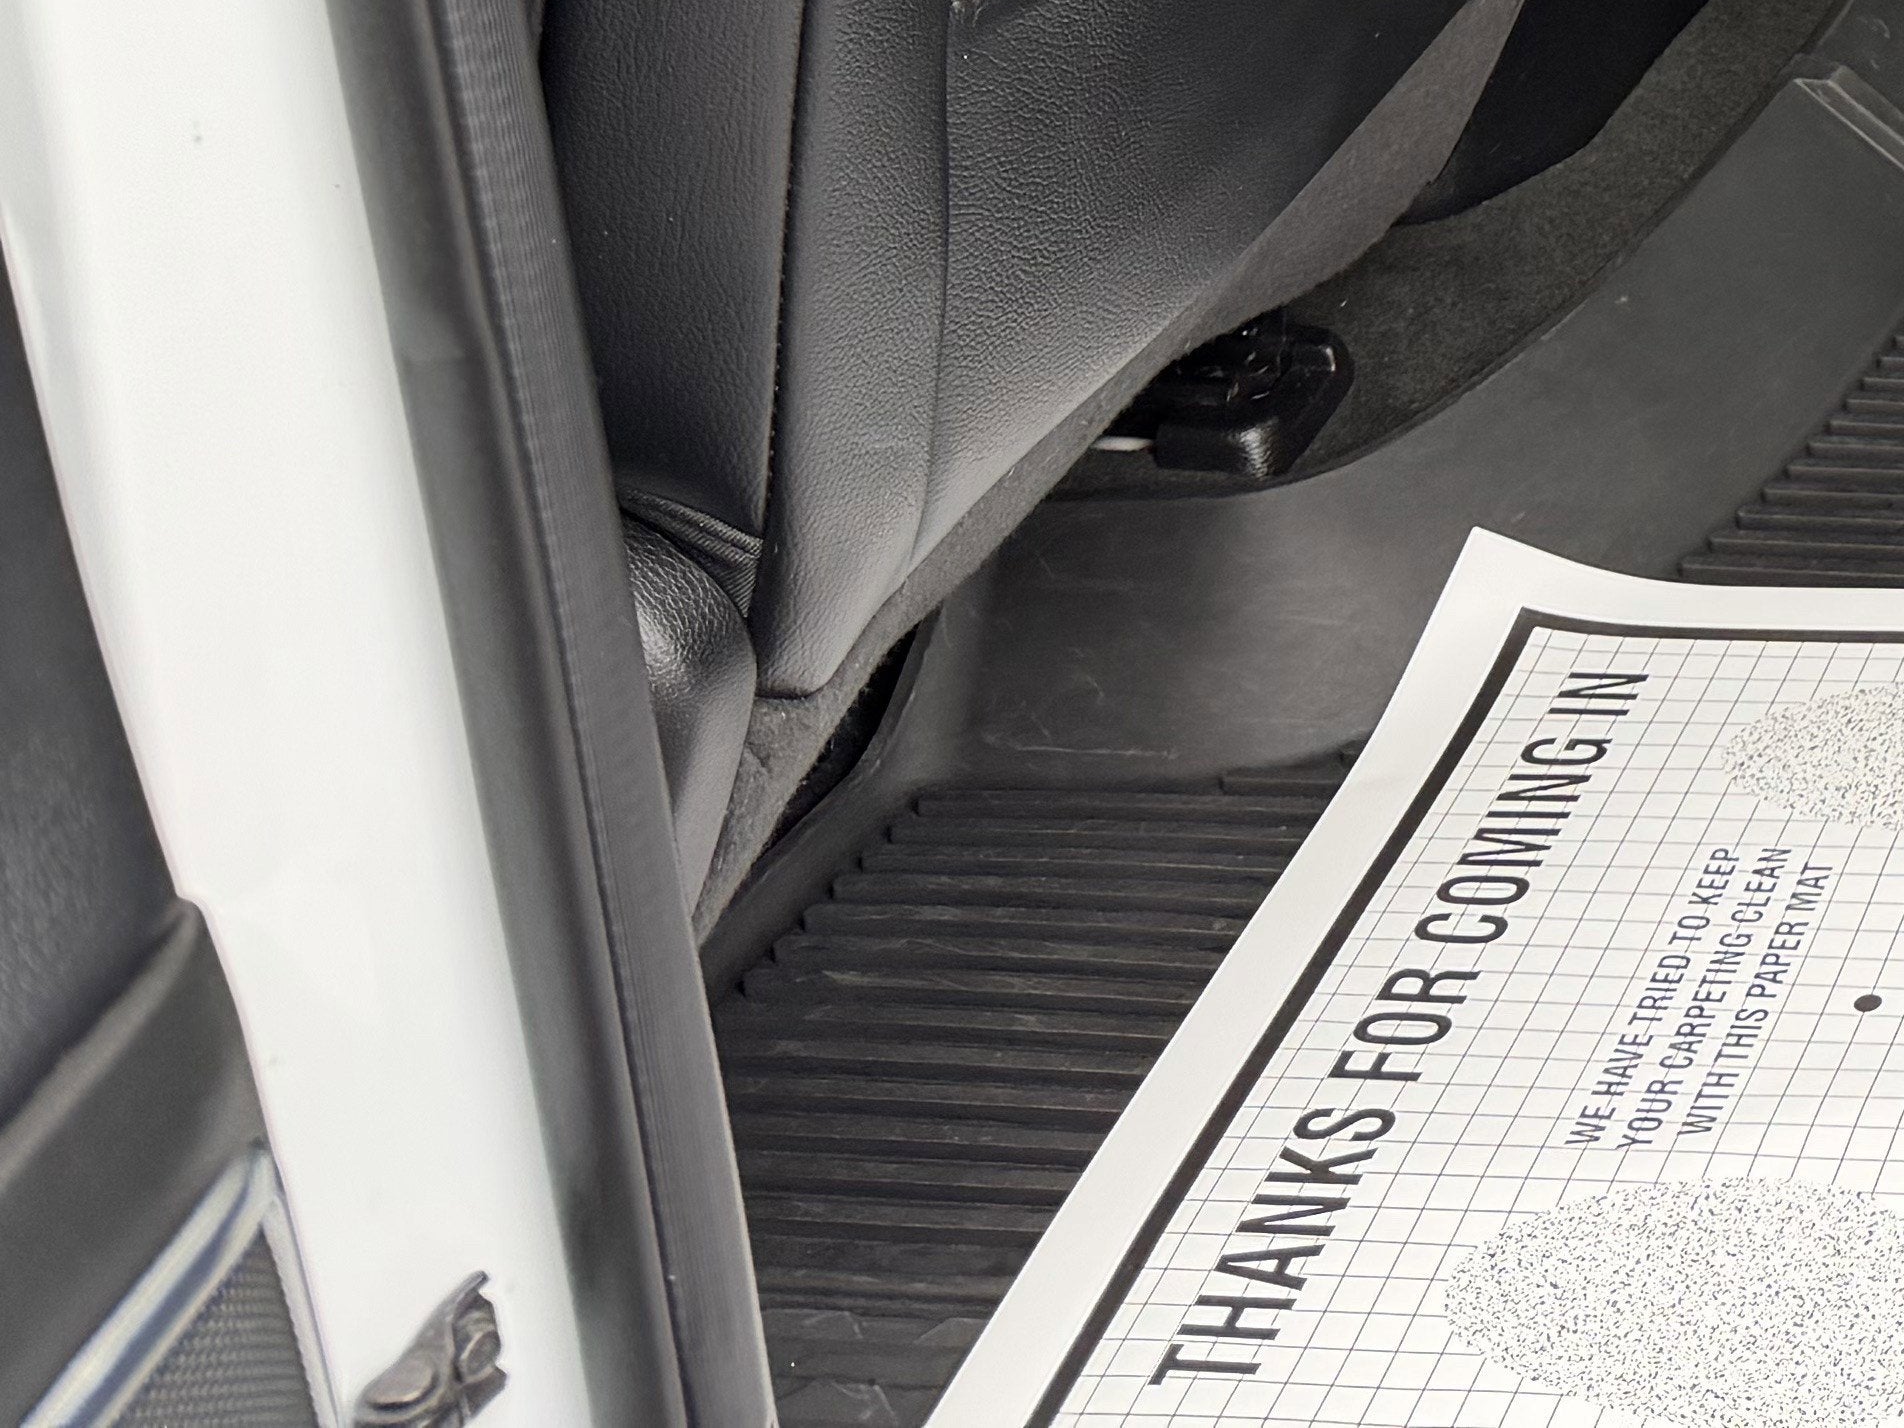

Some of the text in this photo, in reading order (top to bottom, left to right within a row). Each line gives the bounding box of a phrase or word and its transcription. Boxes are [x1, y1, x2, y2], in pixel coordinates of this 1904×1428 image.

[1149, 670, 1649, 1386] THANKS FOR COMING IN
[1564, 847, 1740, 1145] WE HAVE TRIED TO KEEP
[1616, 847, 1792, 1150] YOUR CARPETING CLEAN
[1677, 861, 1834, 1136] WITH THIS PAPER MAT
